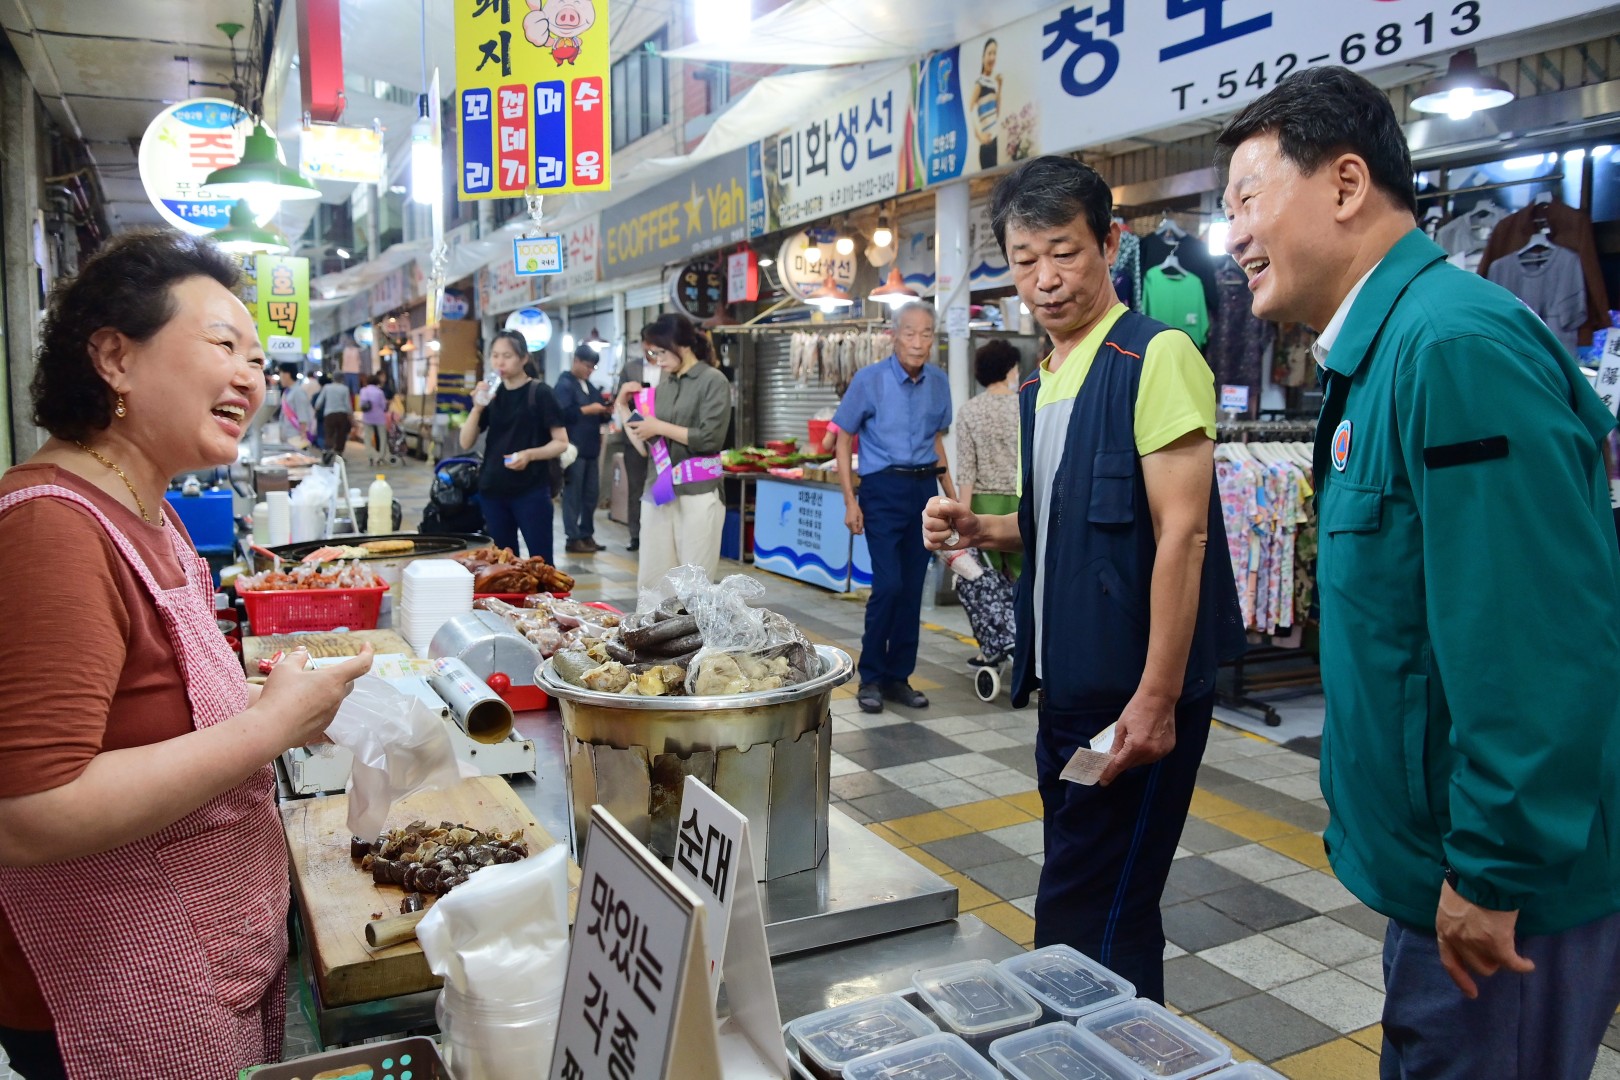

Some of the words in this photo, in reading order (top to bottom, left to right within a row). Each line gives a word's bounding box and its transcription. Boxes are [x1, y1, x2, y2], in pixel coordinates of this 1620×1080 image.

[465, 94, 490, 189] 꼬리
[500, 90, 526, 187] 껍데기
[536, 87, 563, 184] 머리
[574, 81, 600, 180] 수육
[781, 90, 892, 187] 미화생선
[707, 177, 745, 231] Yah
[267, 264, 298, 336] 호떡
[677, 807, 732, 903] 순대
[587, 872, 663, 1015] 맛있는
[583, 971, 638, 1080] 각종
